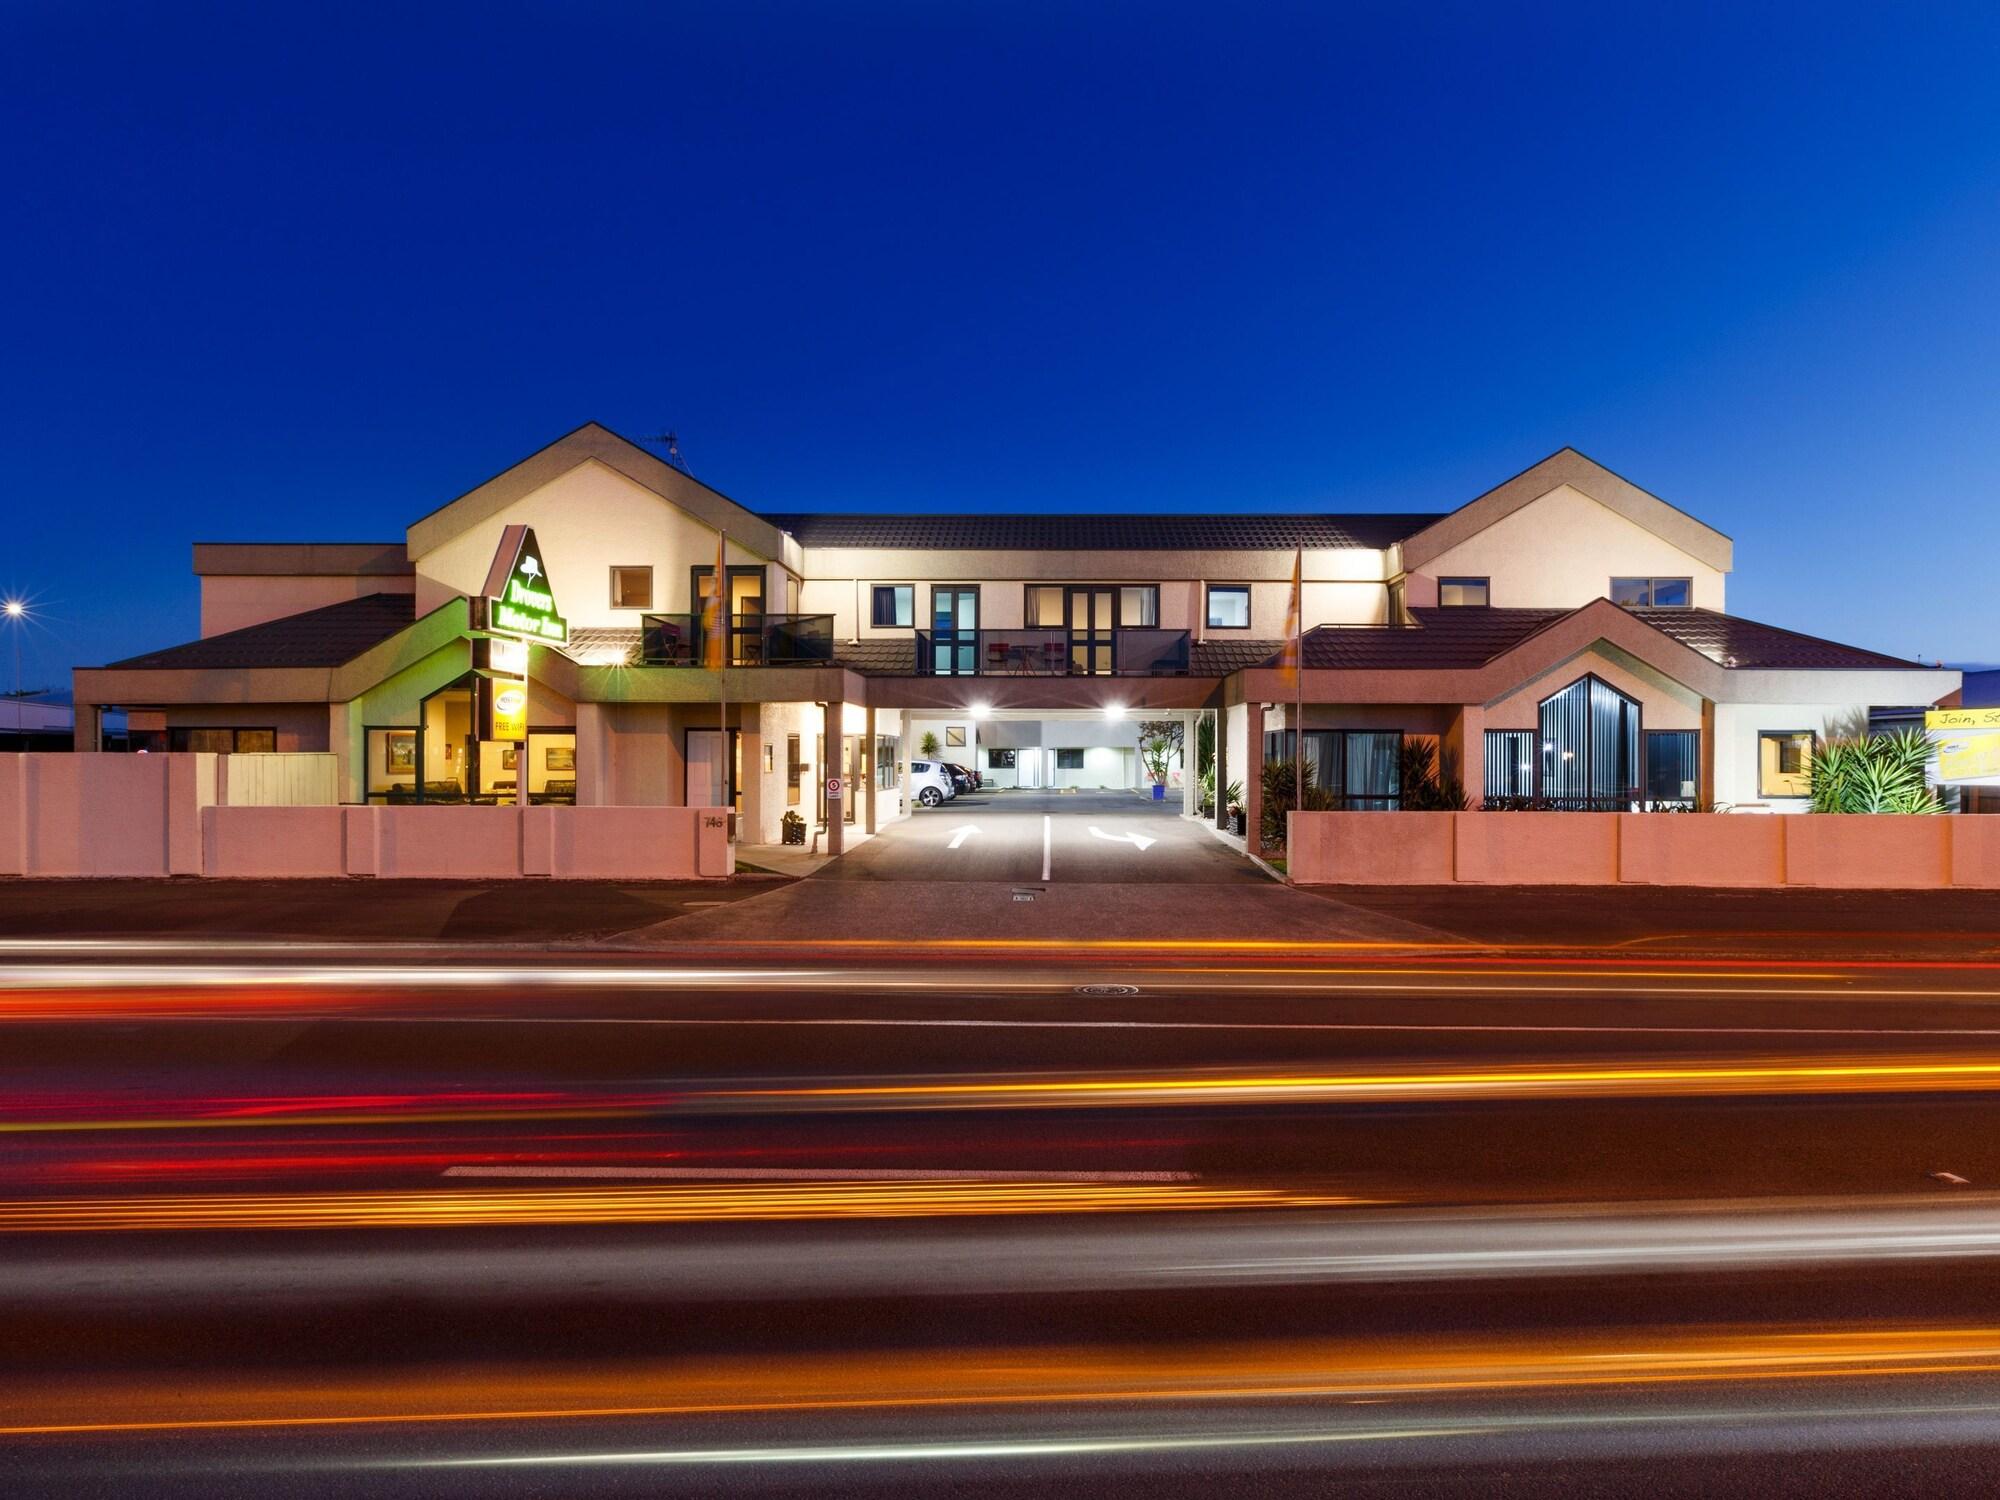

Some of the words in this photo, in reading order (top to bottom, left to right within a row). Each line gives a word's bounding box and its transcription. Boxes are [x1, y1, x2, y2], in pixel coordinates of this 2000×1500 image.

[497, 605, 541, 632] Motor
[540, 615, 563, 638] Inn
[1939, 713, 1976, 725] Join,
[495, 721, 509, 731] FREE
